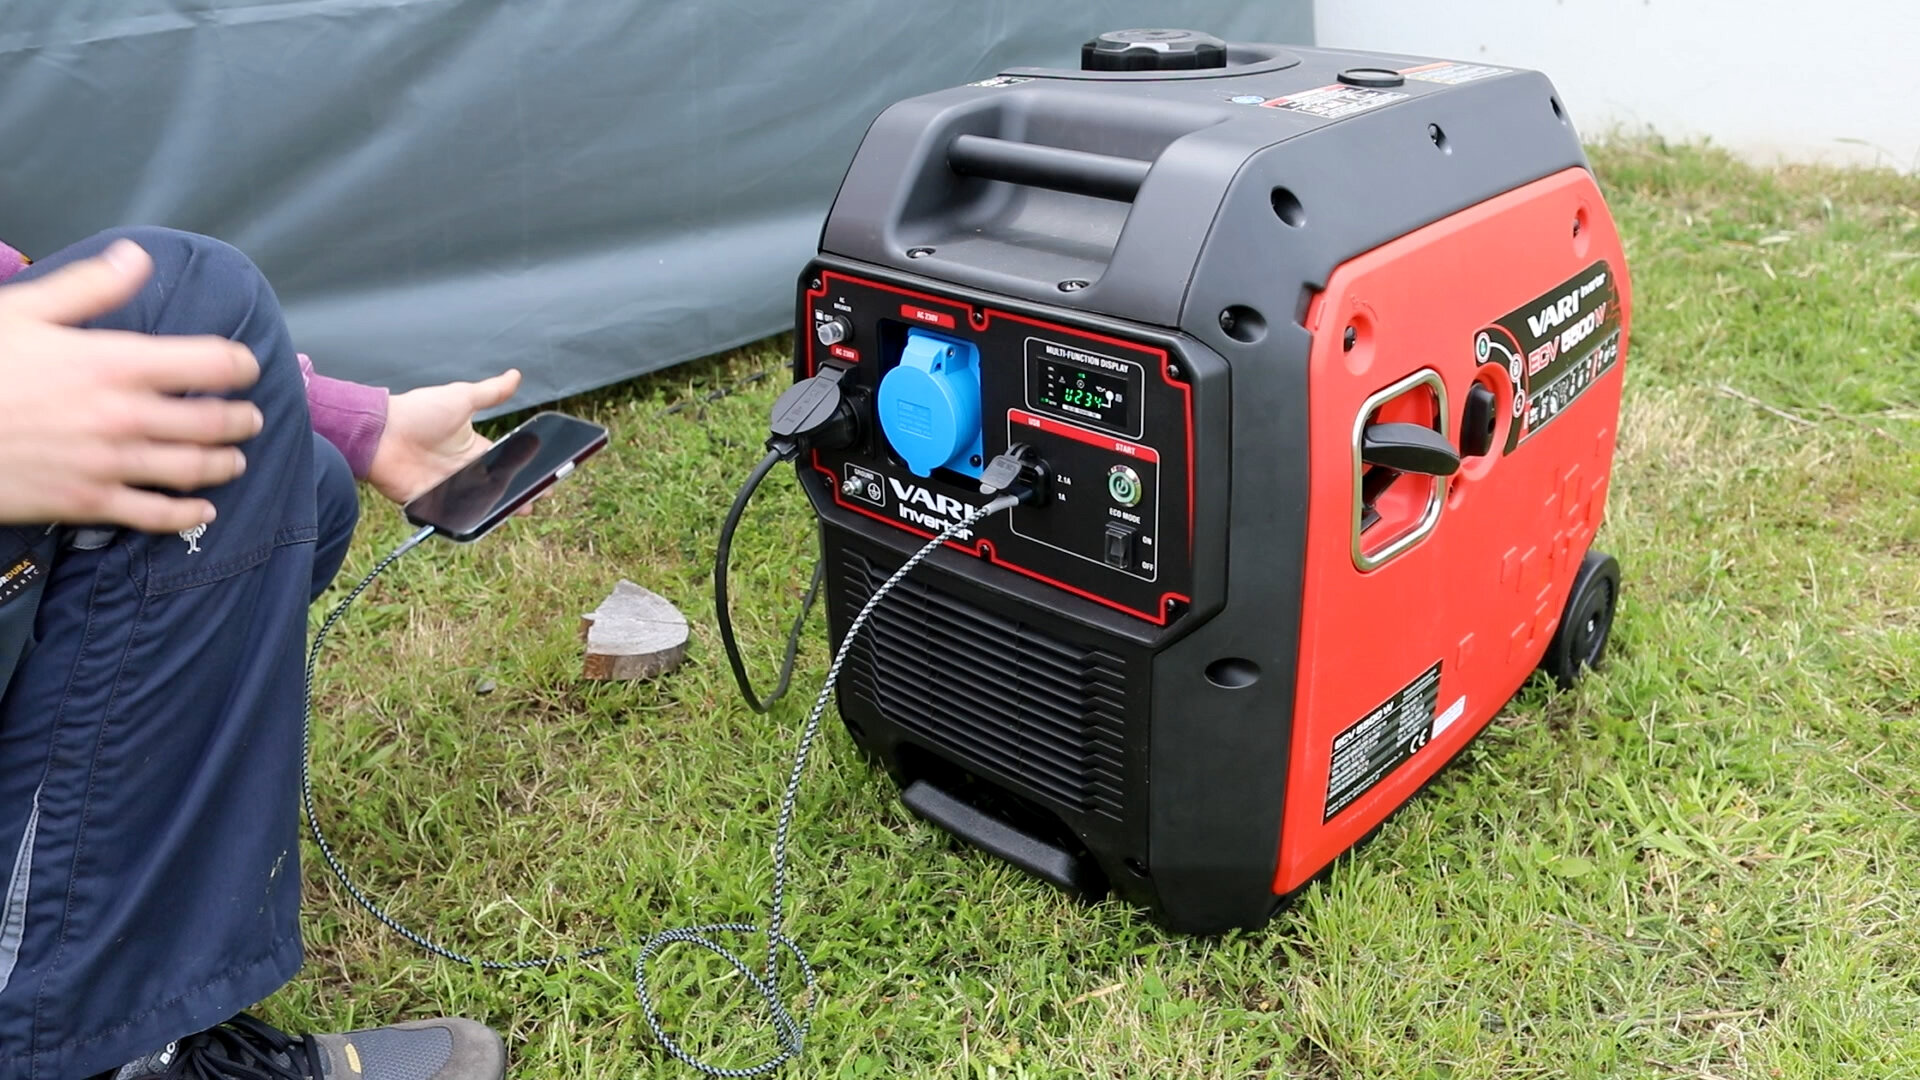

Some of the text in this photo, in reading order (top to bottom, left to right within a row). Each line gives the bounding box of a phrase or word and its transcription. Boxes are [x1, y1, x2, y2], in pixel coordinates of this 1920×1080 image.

[1528, 290, 1580, 338] VARI
[1046, 345, 1129, 373] MULTI-FUNCTION DISPLAY
[1028, 418, 1041, 427] USB
[1115, 443, 1136, 455] START
[1057, 475, 1072, 485] 2.1A
[1109, 507, 1141, 524] ECO MODE
[1142, 561, 1154, 571] OFF
[159, 1041, 176, 1065] BO
